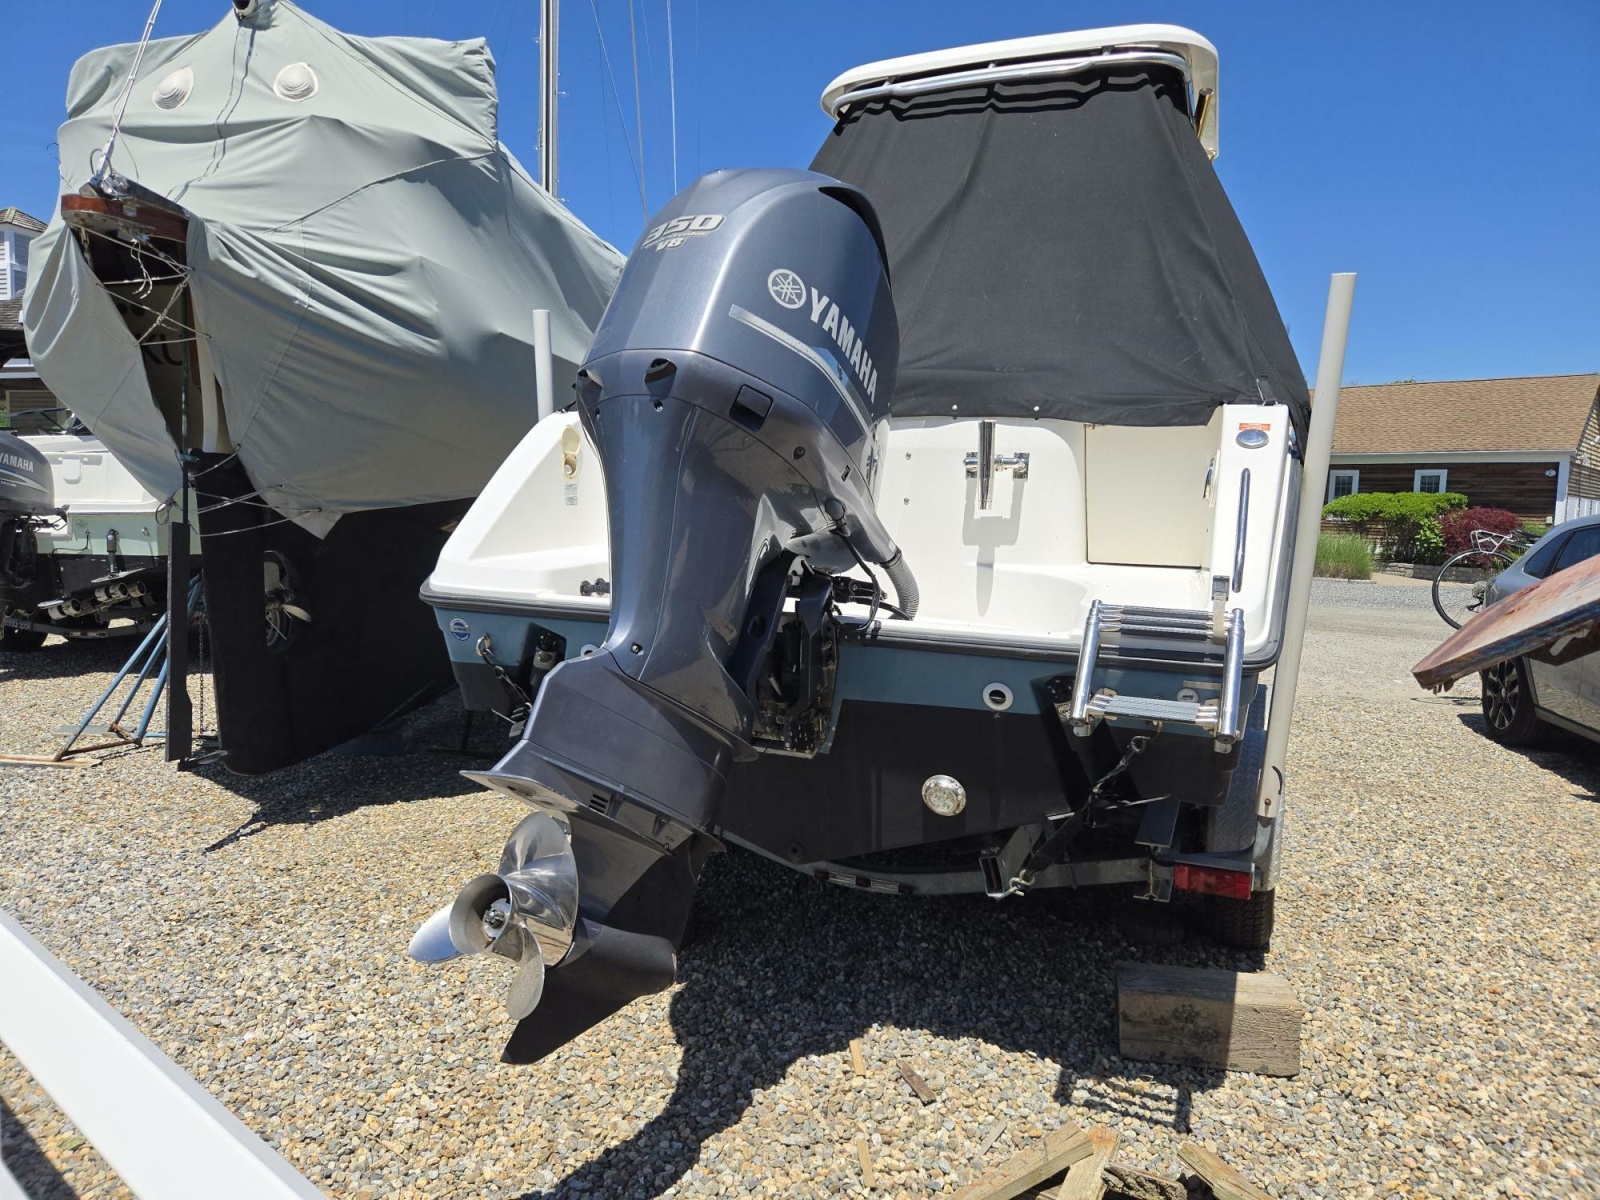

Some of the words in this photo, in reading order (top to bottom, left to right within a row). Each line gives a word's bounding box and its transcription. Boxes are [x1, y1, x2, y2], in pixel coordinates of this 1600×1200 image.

[642, 214, 723, 247] 350
[656, 237, 685, 252] V8
[810, 286, 878, 404] YAMAHA
